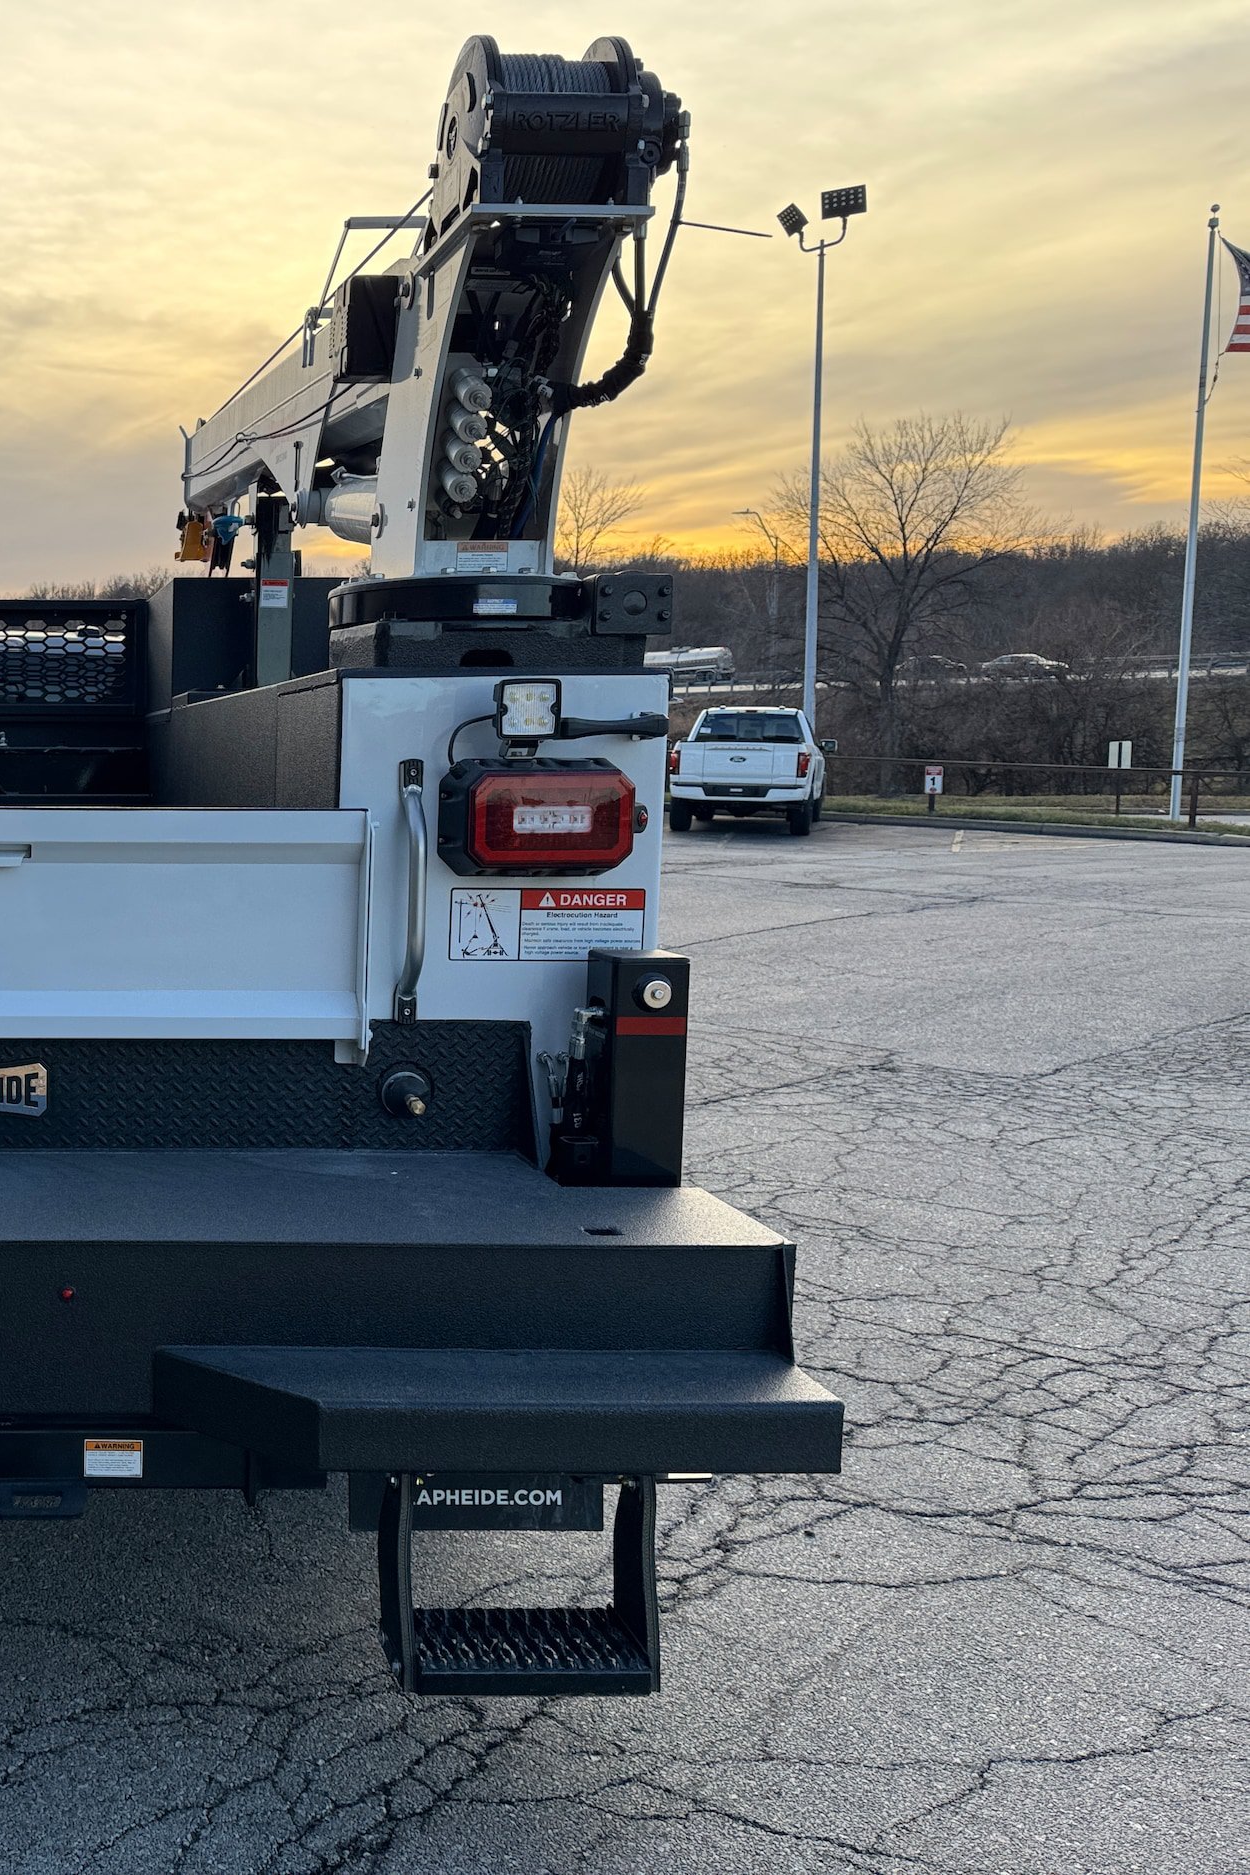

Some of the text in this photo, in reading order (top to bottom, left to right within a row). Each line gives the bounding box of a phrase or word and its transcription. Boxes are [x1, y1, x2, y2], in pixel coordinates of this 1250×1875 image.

[511, 111, 620, 132] ROTZLER
[930, 776, 936, 786] 1
[560, 894, 627, 906] DANGER
[413, 1489, 562, 1506] APHEIDE.COM
